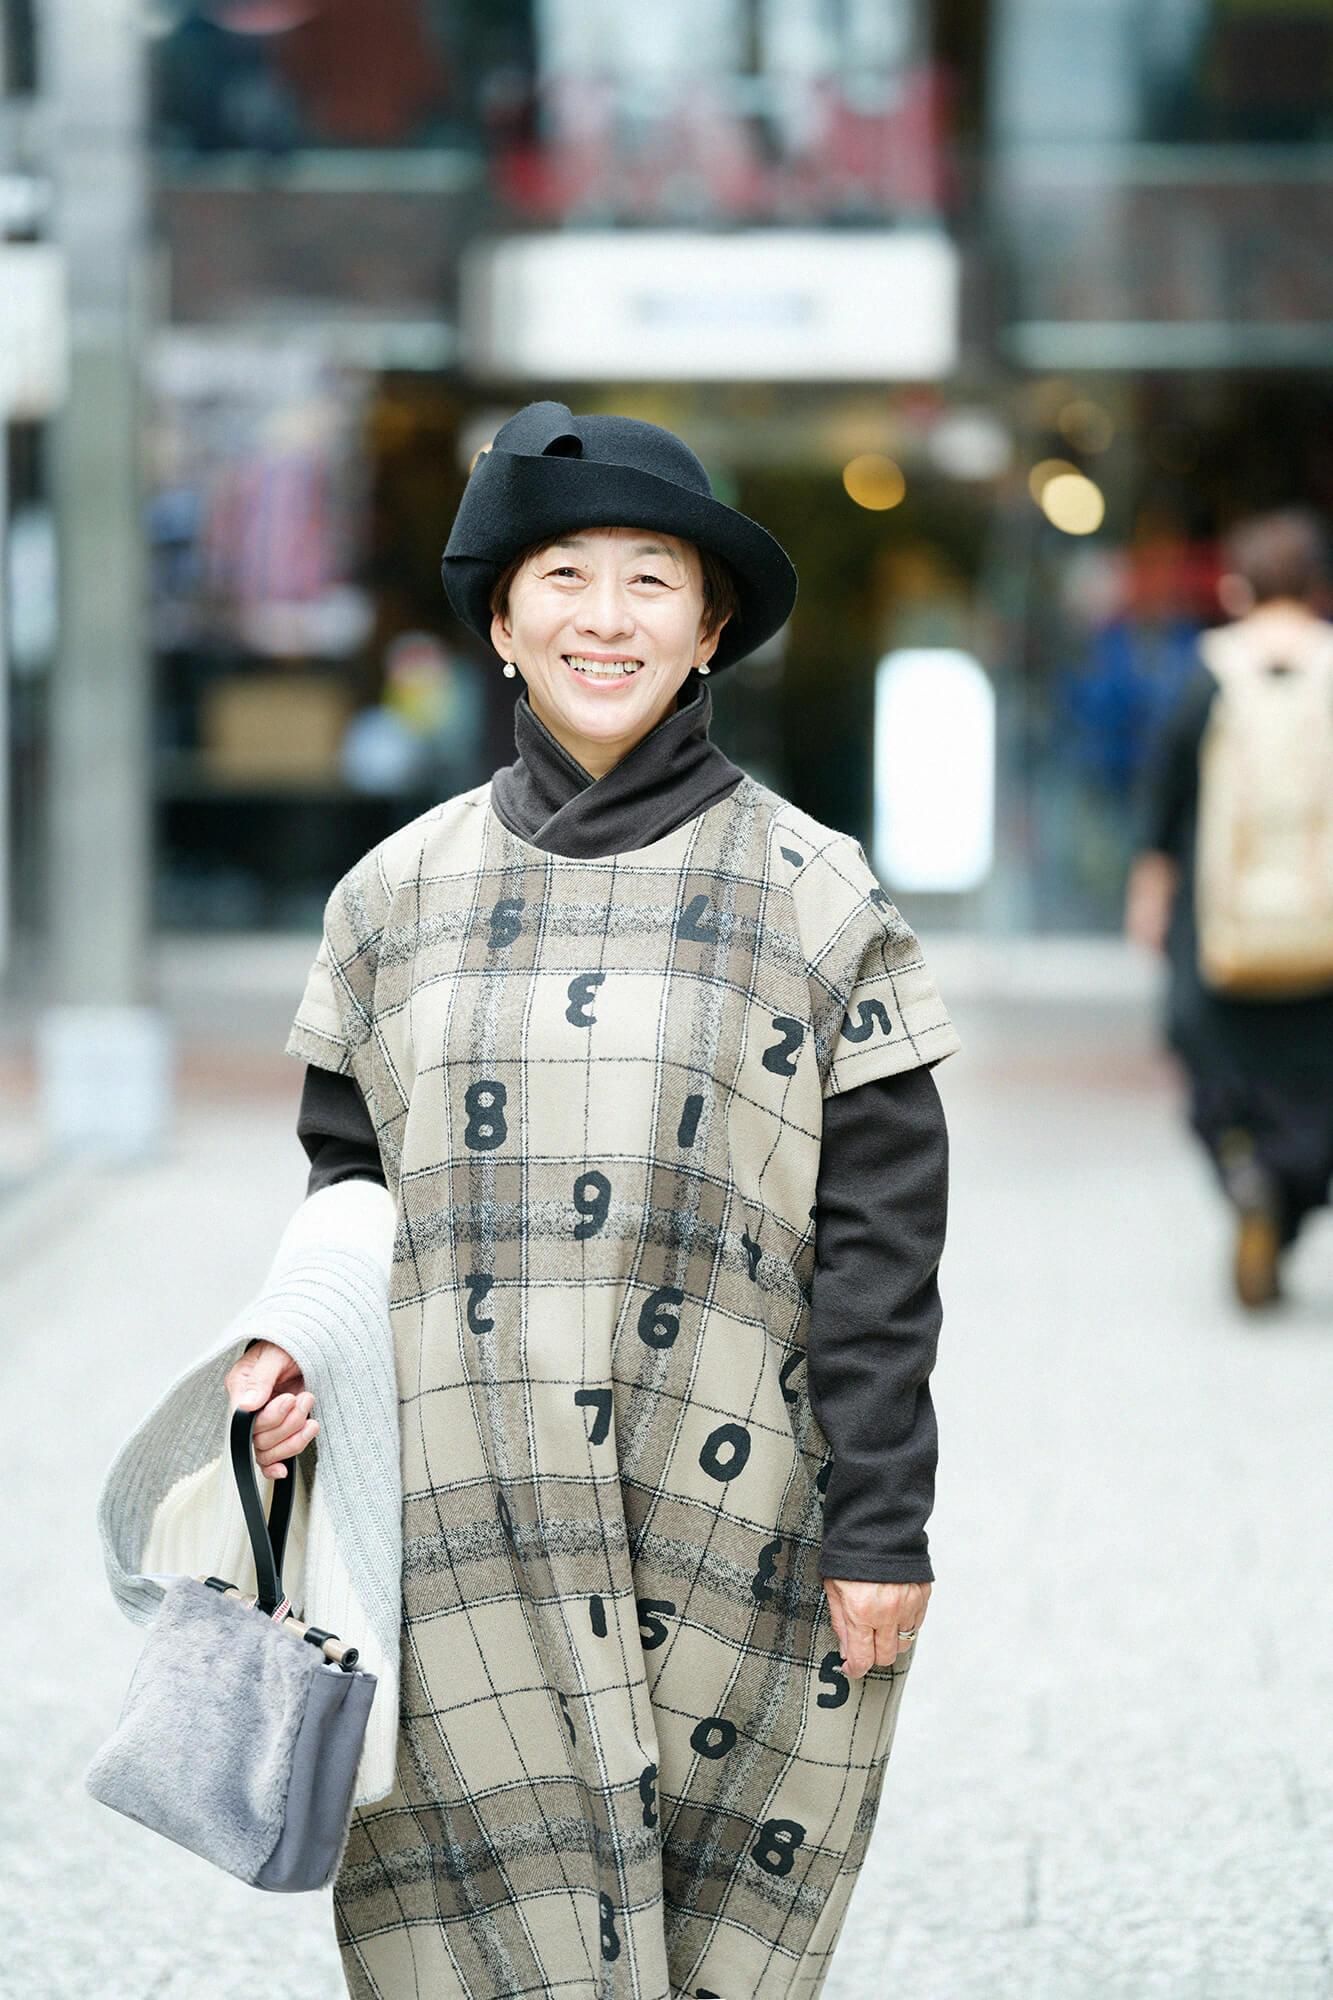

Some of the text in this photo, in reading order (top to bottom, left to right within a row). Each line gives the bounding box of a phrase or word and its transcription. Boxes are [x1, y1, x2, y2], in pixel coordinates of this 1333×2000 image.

[565, 972, 606, 1028] 3
[464, 1080, 507, 1151] 8
[677, 1094, 704, 1148] 1
[573, 1171, 611, 1240] 9
[638, 1286, 684, 1349] 6
[574, 1388, 612, 1446] 7
[699, 1422, 751, 1482] 0
[589, 1594, 608, 1638] 1
[817, 1651, 849, 1709] 5
[690, 1717, 737, 1760] 0
[751, 1818, 806, 1878] 8
